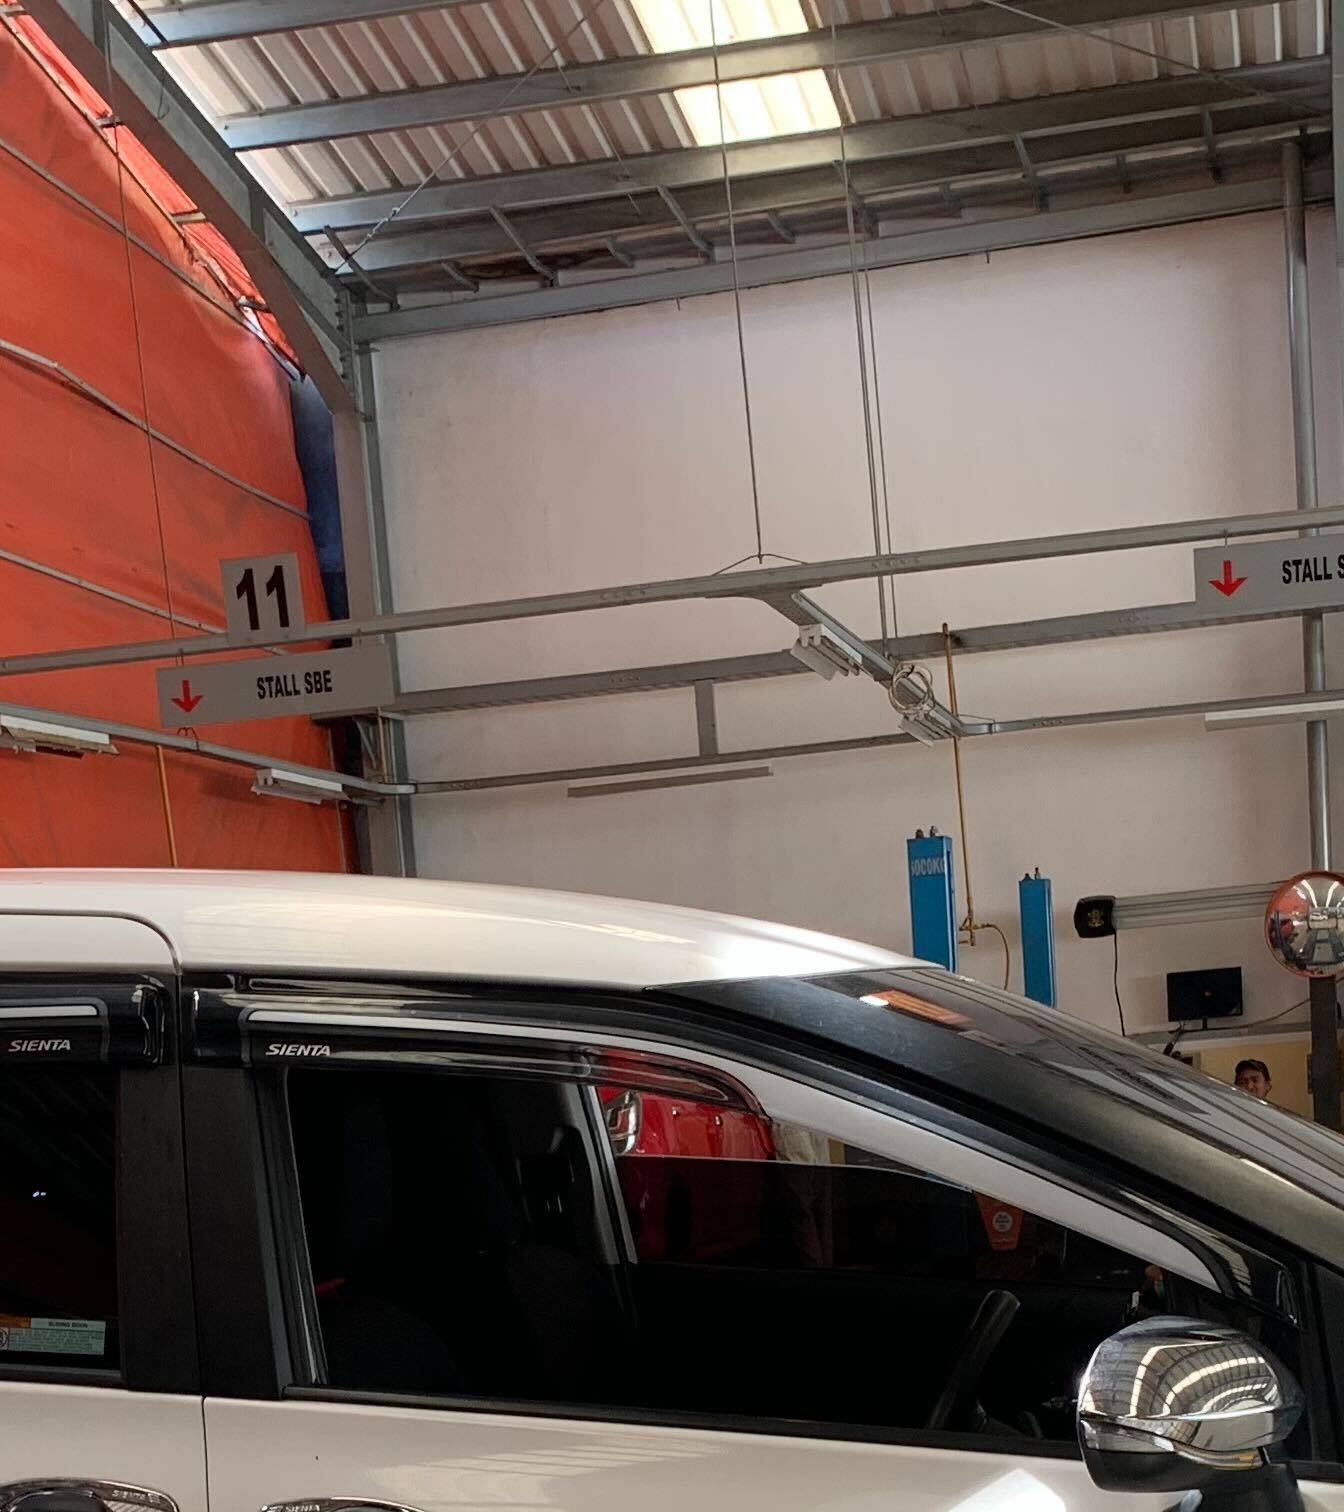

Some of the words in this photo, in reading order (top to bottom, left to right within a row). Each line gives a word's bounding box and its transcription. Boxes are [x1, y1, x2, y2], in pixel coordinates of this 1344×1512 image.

[1281, 556, 1333, 585] STALL
[235, 564, 290, 631] 11
[256, 674, 300, 700] STALL
[304, 669, 333, 694] SBE
[7, 1038, 72, 1053] SIENTA
[264, 1042, 332, 1058] SIENTA
